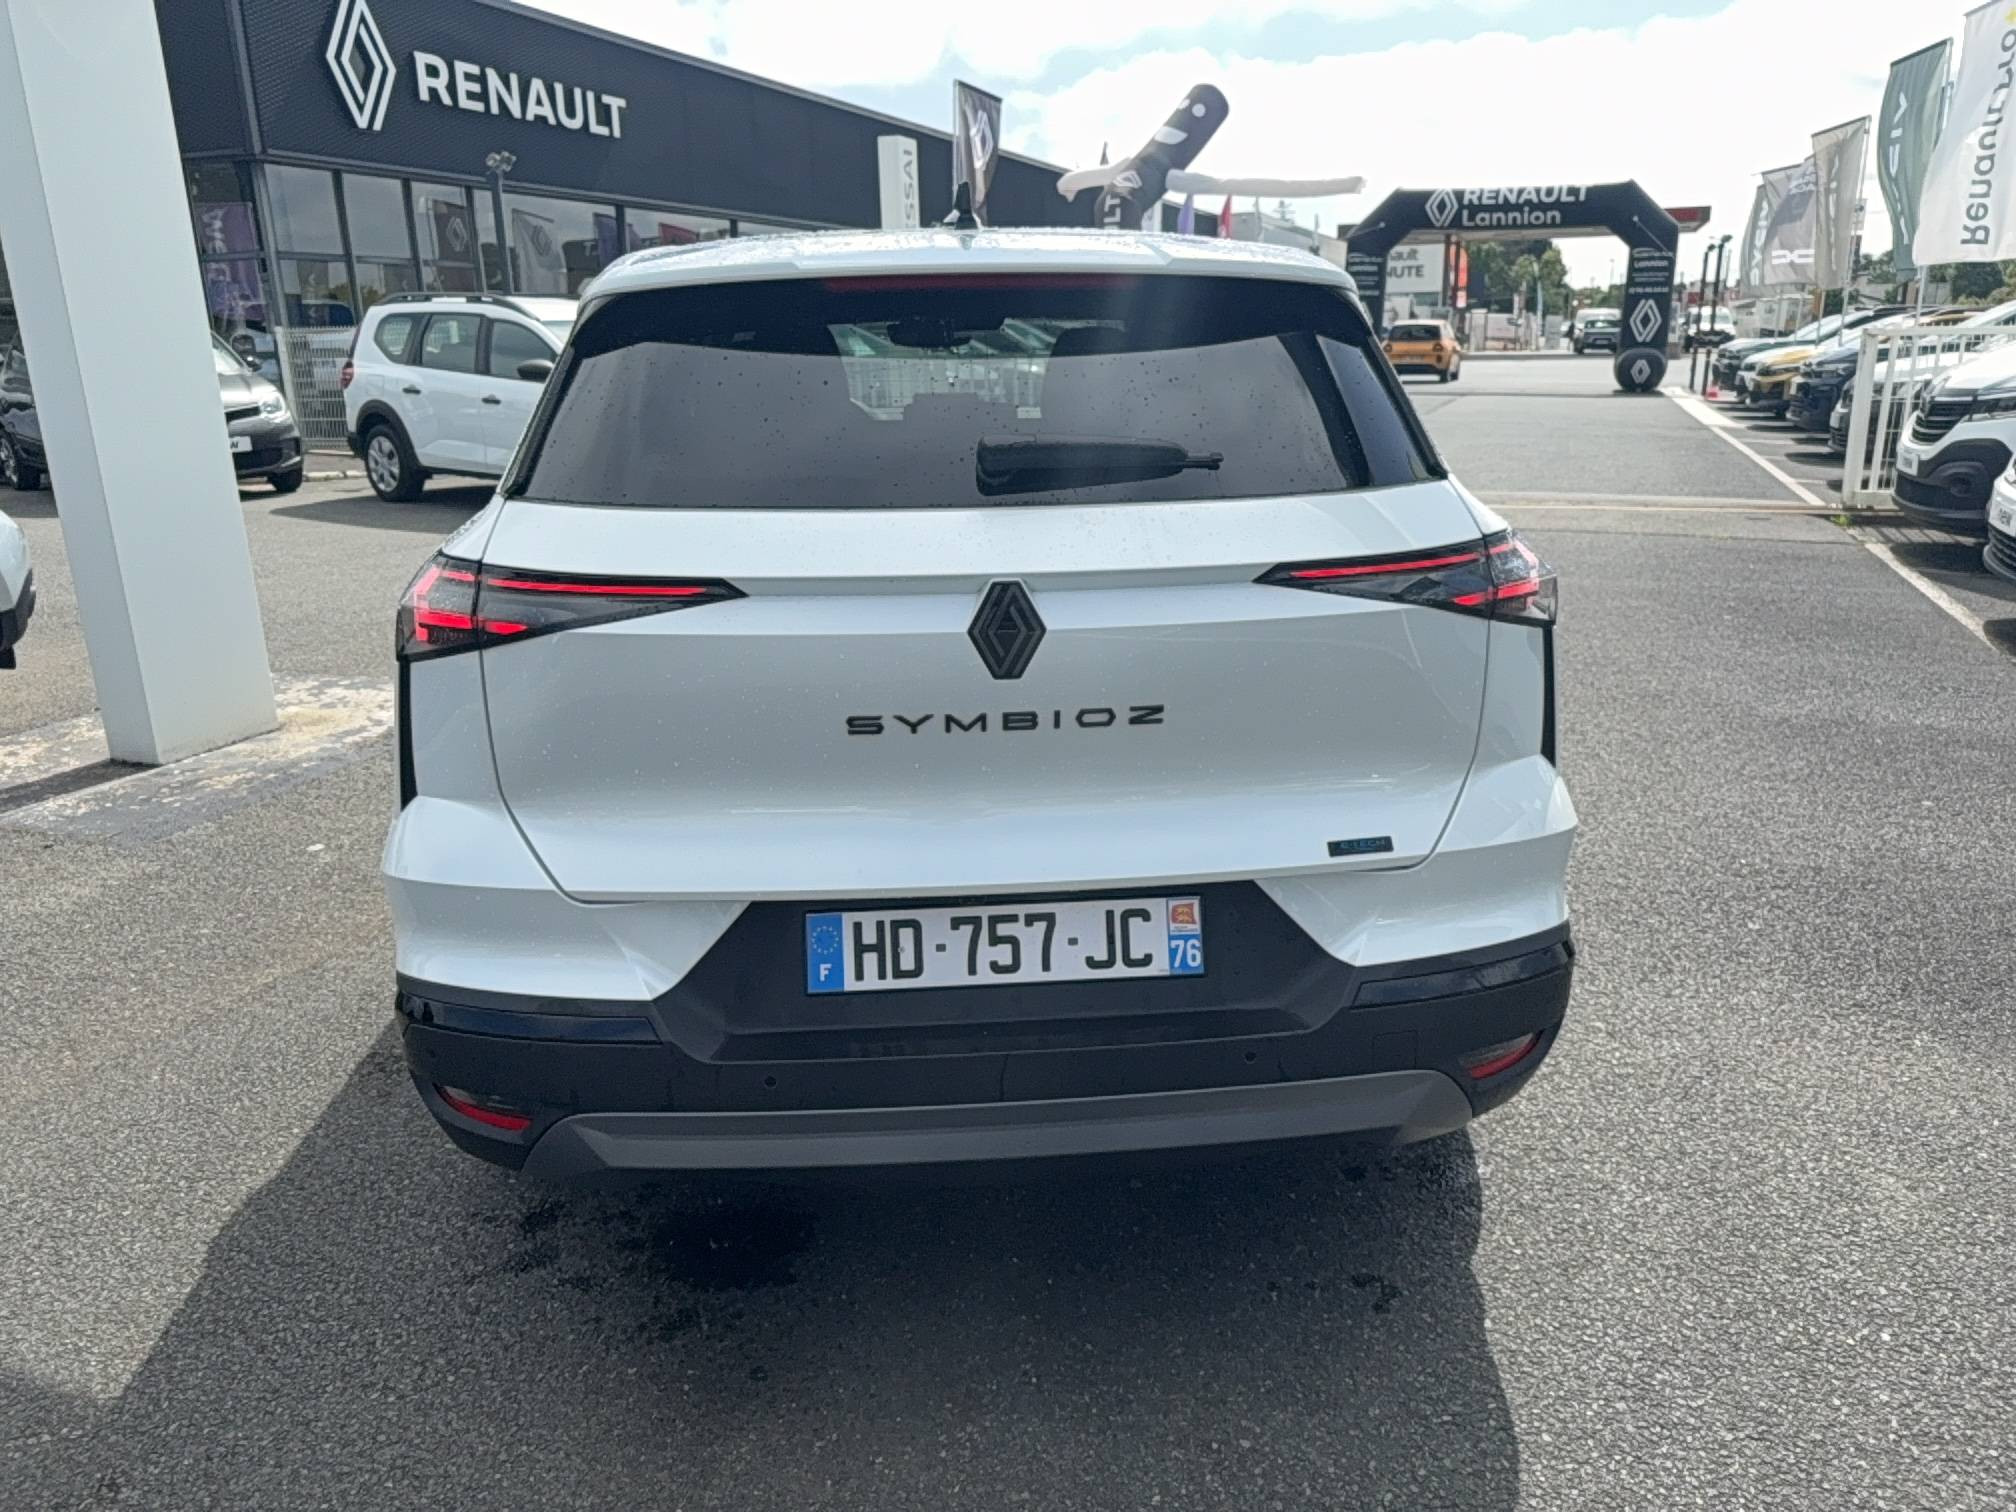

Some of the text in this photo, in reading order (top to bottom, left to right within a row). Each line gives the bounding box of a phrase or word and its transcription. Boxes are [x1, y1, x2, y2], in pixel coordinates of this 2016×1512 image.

[413, 50, 627, 139] RENAULT
[903, 149, 915, 228] SSAI
[1463, 184, 1588, 205] RENAULT
[1461, 206, 1562, 227] Lannion
[845, 704, 1165, 735] SYMBIOZ
[818, 908, 1201, 982] F HD-757-JC 76
